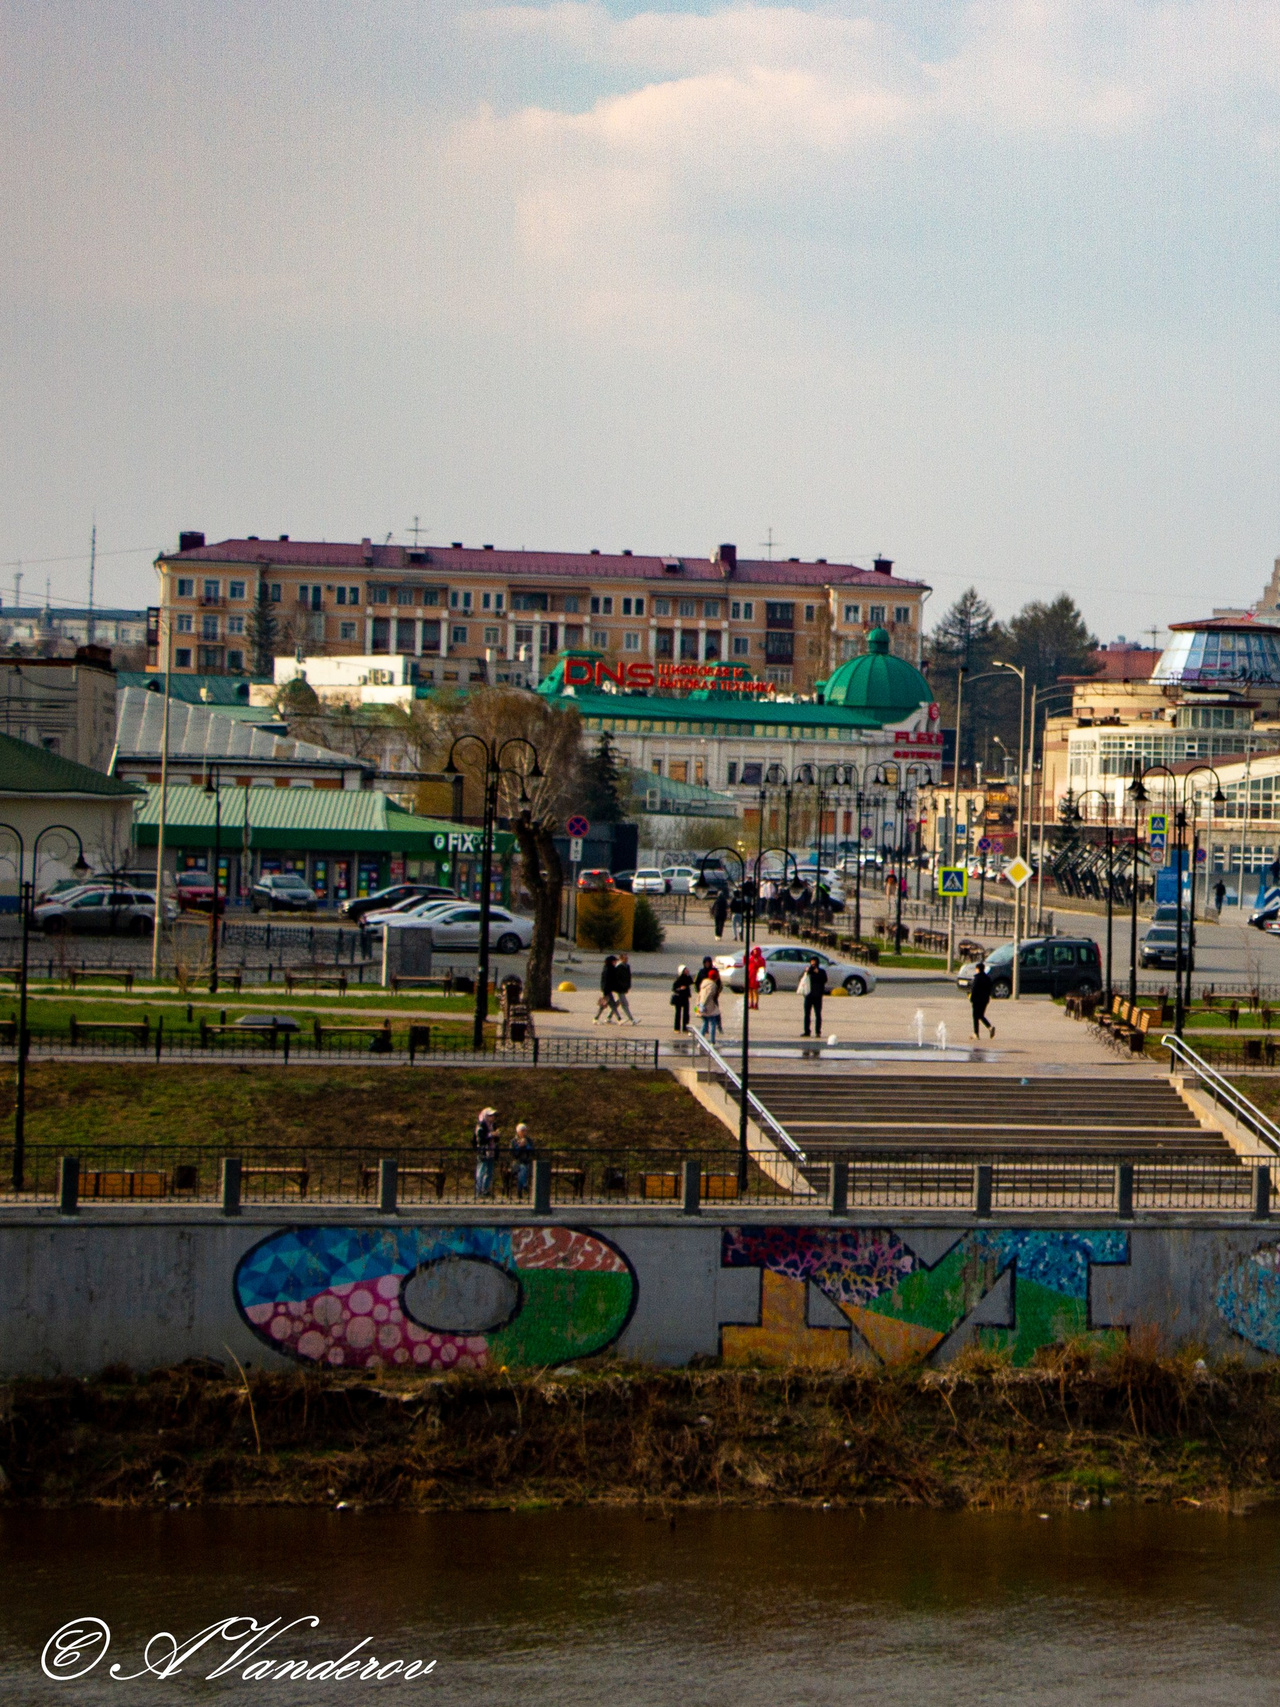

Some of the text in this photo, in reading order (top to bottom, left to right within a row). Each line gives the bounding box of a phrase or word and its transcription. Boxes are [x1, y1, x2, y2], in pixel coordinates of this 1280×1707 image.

[564, 659, 655, 688] DNS
[658, 663, 730, 678] ЦИФРОВАЯ
[658, 677, 777, 693] БЫТОВАЯ ТЕХНИКА
